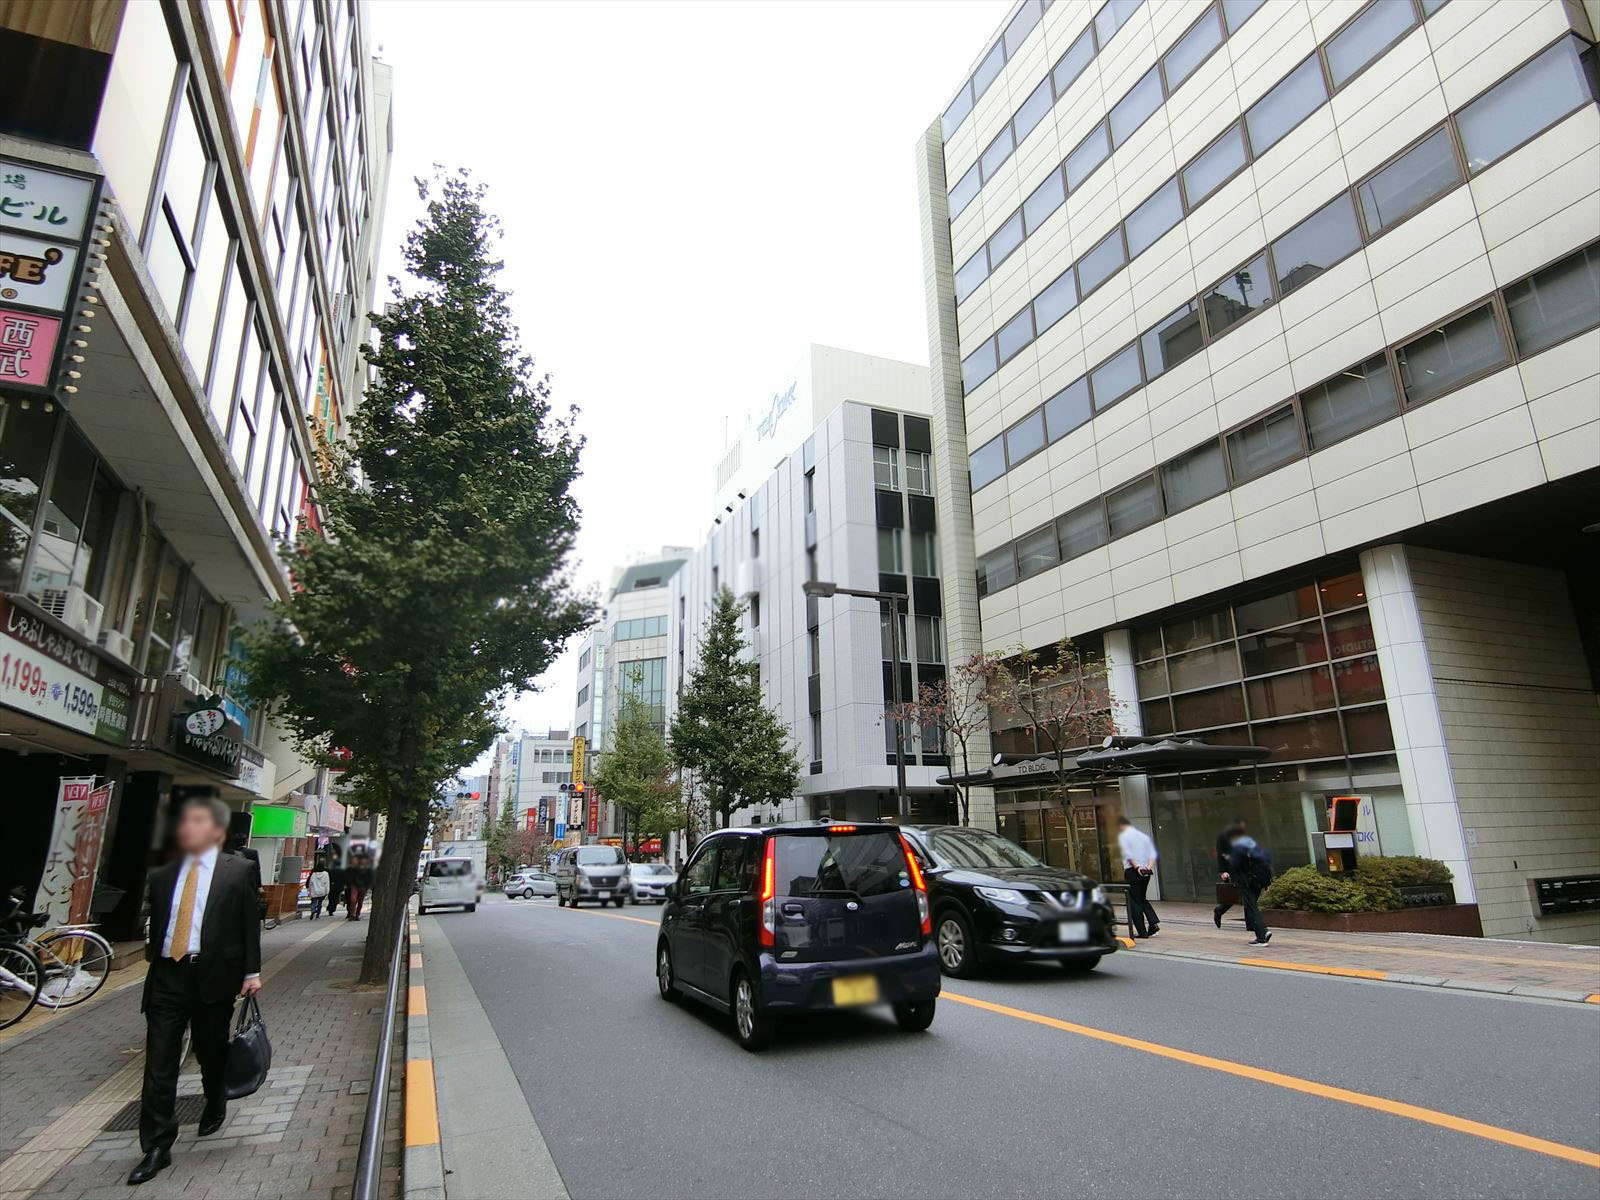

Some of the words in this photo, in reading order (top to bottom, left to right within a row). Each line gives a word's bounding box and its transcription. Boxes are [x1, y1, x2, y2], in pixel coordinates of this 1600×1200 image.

[0, 197, 68, 226] ビル
[575, 745, 583, 784] やきとりセン
